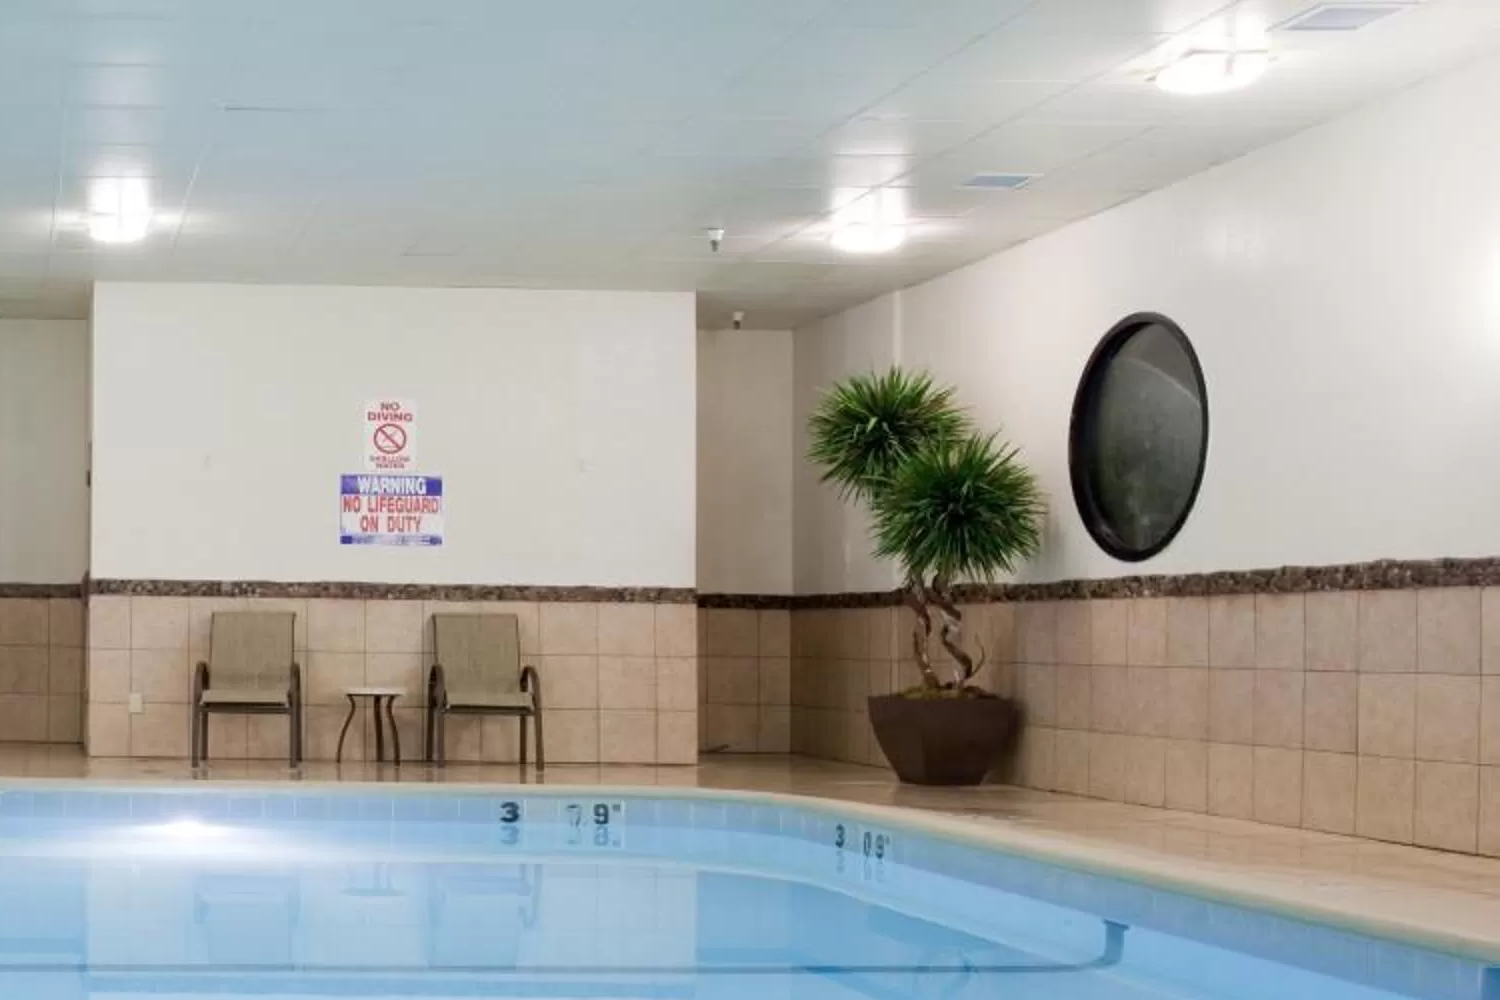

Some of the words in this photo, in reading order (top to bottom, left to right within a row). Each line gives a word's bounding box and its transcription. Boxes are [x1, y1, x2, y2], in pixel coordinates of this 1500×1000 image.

[380, 402, 400, 411] NO
[367, 411, 413, 422] DIVING
[357, 476, 426, 494] WARNING
[343, 496, 361, 512] NO
[367, 496, 438, 513] LIFEGUARD
[360, 515, 378, 532] ON
[387, 515, 421, 532] DUTY
[500, 802, 520, 823] 3
[835, 824, 845, 849] 3
